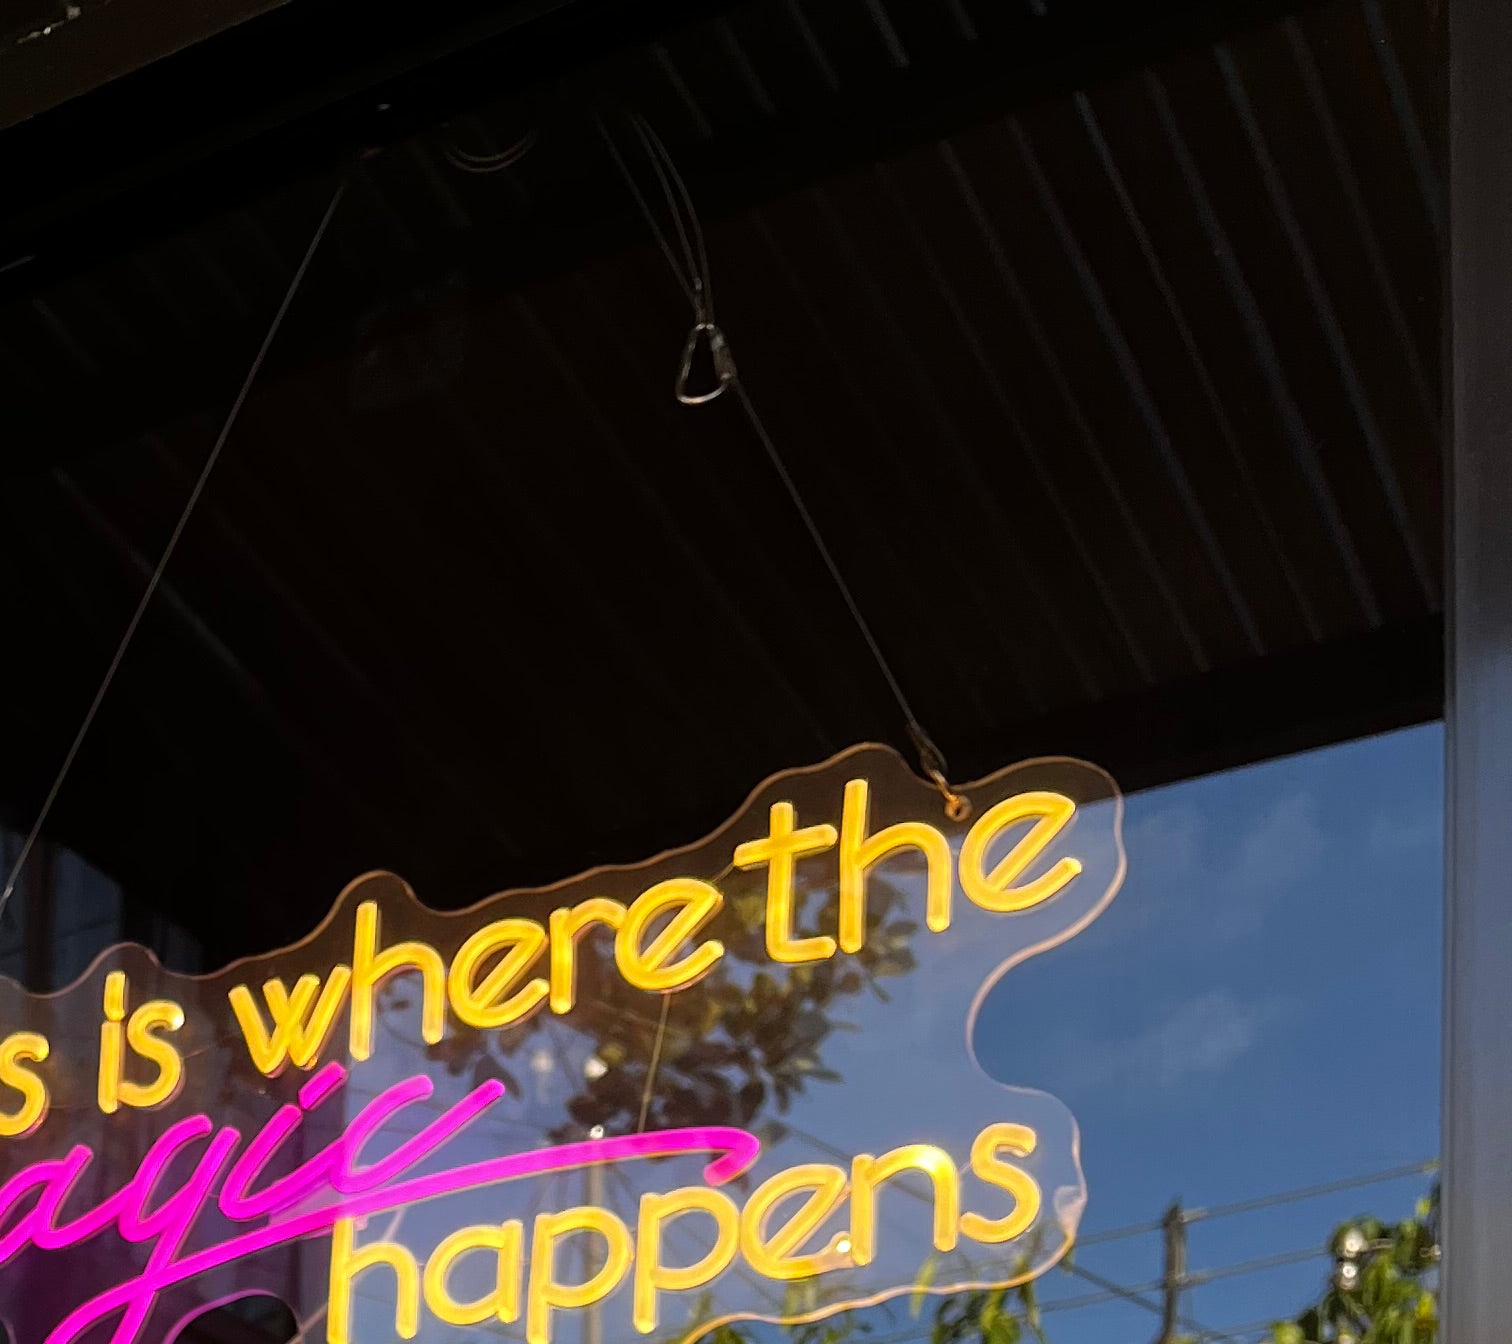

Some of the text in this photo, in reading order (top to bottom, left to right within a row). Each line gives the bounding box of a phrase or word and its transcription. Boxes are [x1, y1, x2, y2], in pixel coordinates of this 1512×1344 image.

[97, 969, 186, 1114] is
[227, 876, 725, 1074] where
[732, 778, 1084, 964] the
